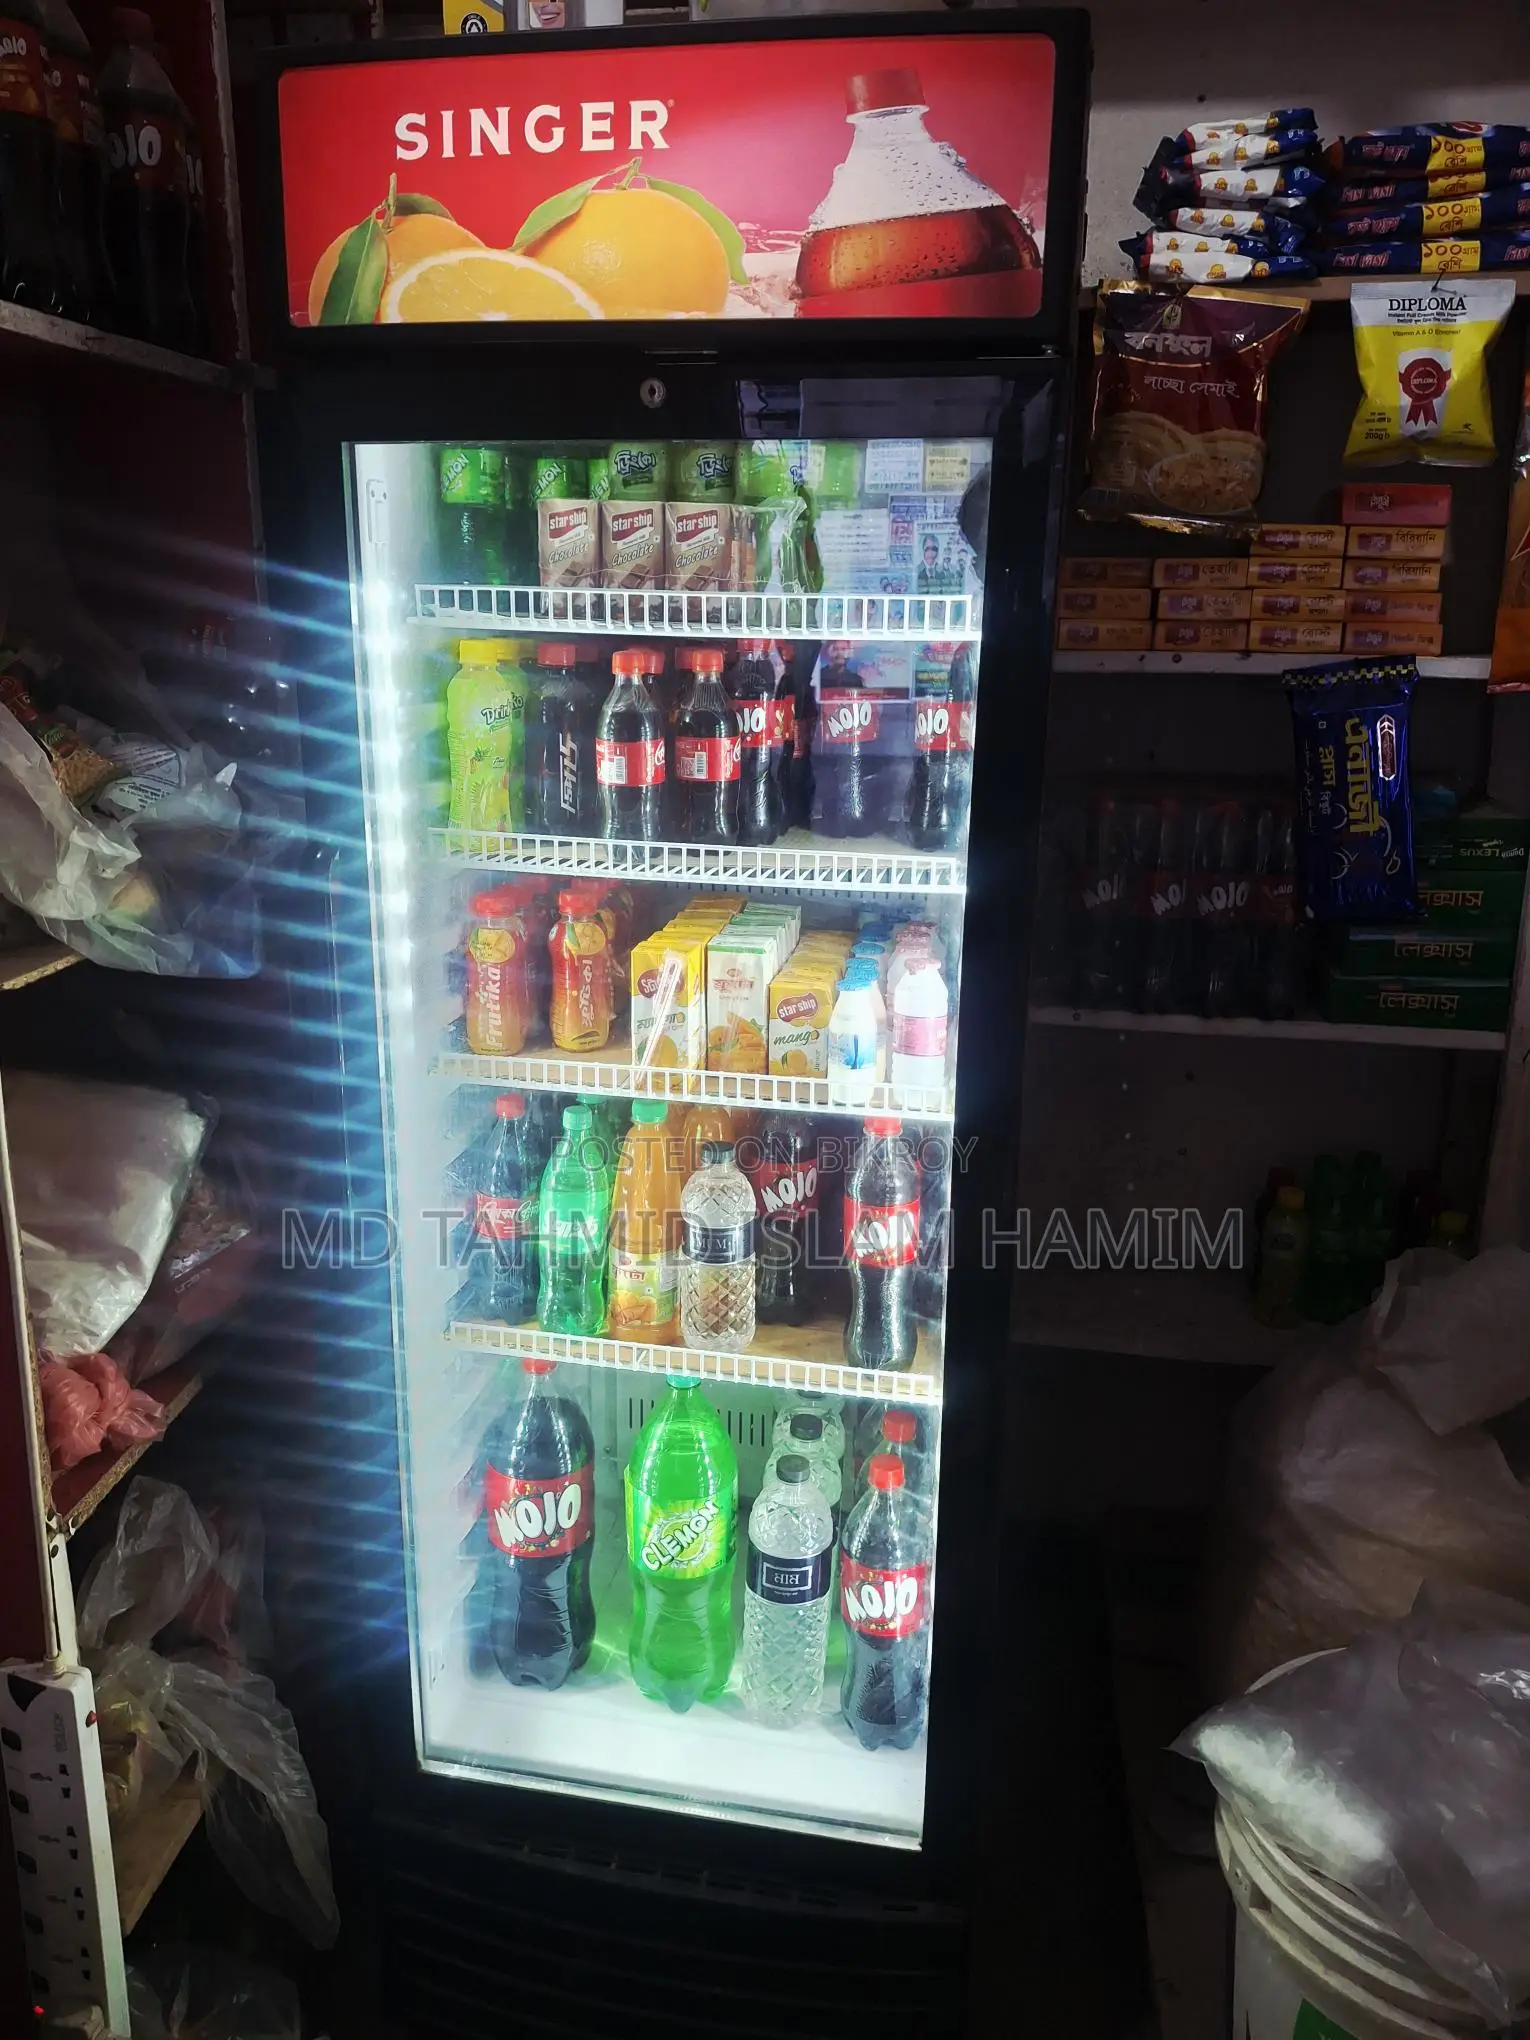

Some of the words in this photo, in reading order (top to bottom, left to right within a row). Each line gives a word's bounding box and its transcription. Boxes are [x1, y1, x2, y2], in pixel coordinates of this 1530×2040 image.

[394, 100, 671, 161] SINGER
[1388, 297, 1467, 312] DIPLOMA
[612, 519, 632, 532] star
[633, 513, 653, 528] ship
[698, 513, 717, 529] ship
[612, 543, 654, 567] Chocolate
[675, 545, 718, 568] Chocolate
[827, 699, 873, 738] MOJO
[774, 1029, 820, 1046] mango
[493, 1483, 582, 1548] MOJO
[640, 1500, 720, 1571] CLEMON
[844, 1575, 918, 1622] MOJO
